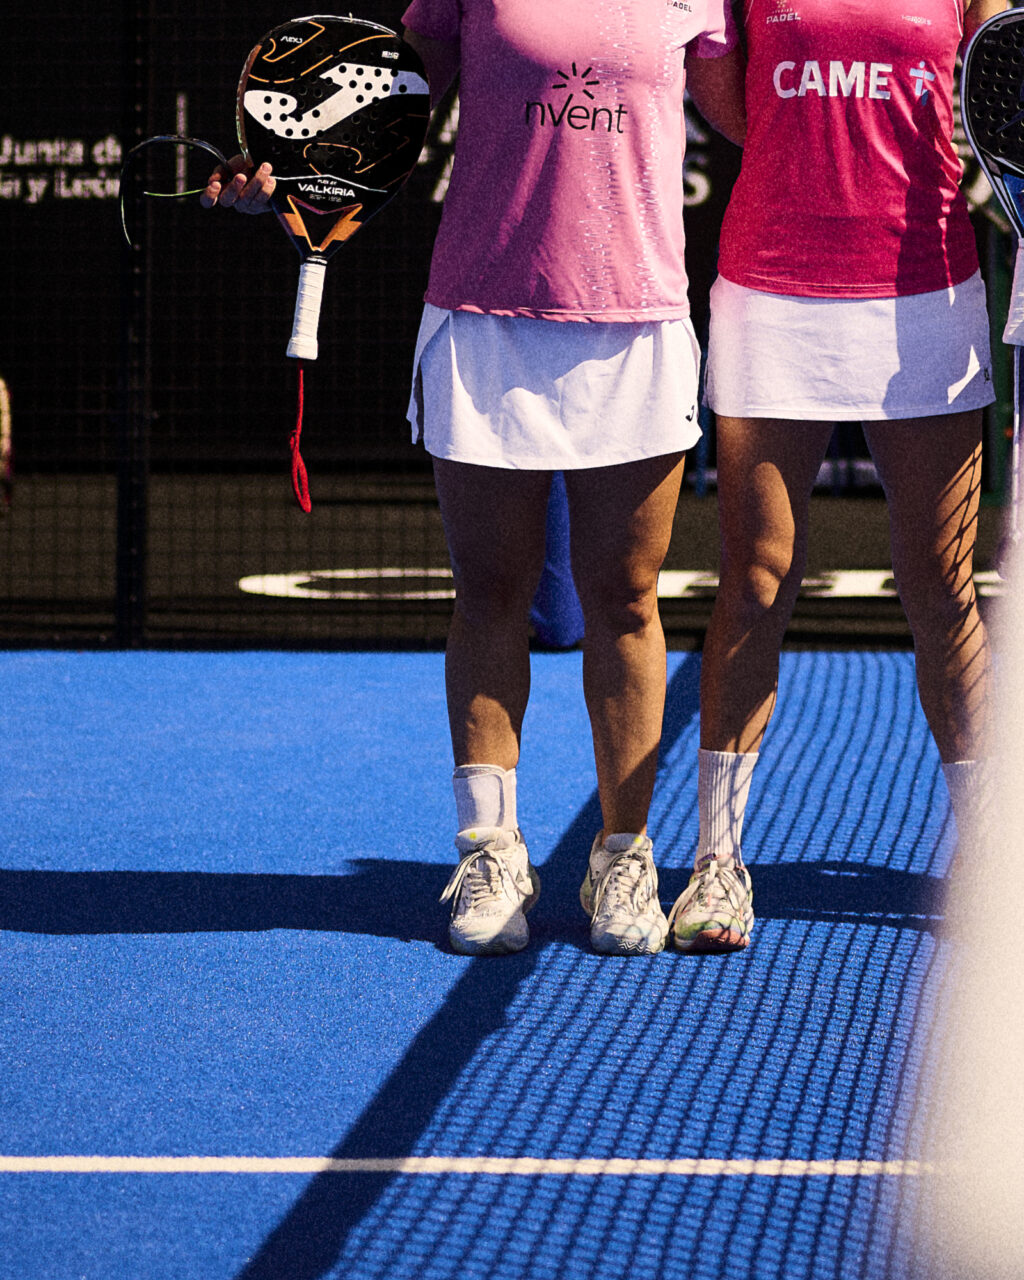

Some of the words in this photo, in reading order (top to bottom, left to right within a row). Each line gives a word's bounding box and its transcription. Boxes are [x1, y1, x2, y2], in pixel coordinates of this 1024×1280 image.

[766, 12, 801, 24] PADEL
[773, 60, 893, 100] CAME
[297, 182, 356, 198] VALKIRIA
